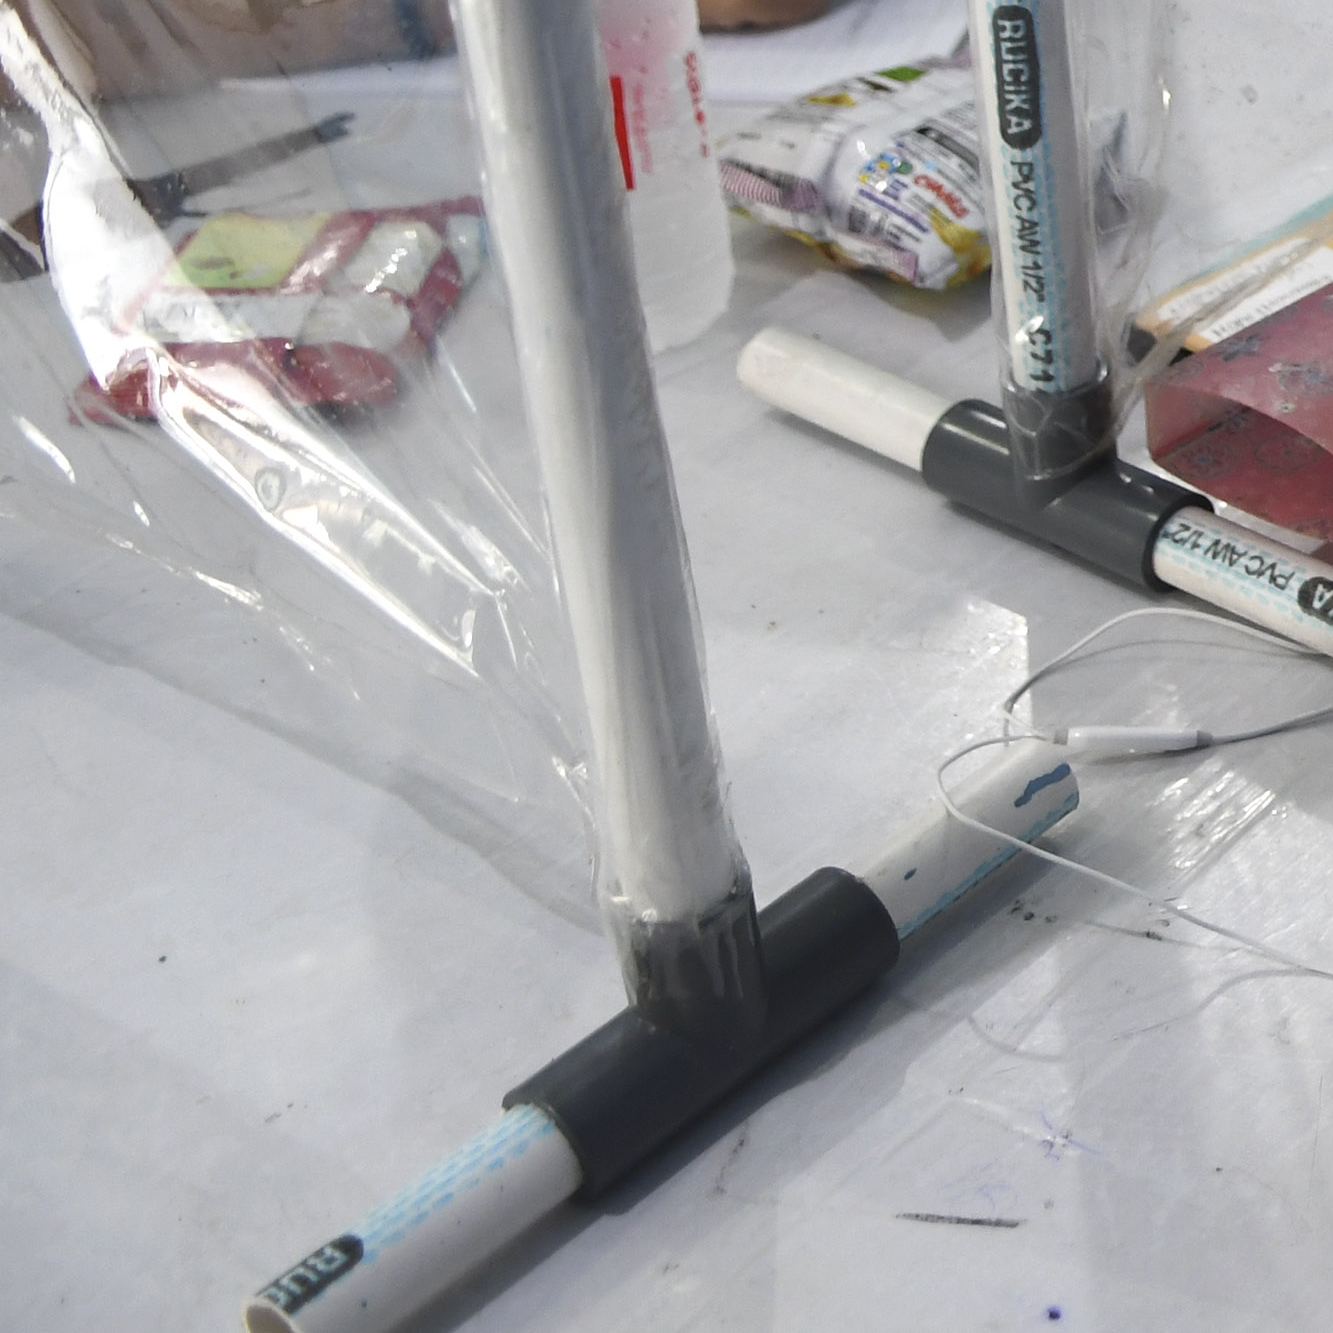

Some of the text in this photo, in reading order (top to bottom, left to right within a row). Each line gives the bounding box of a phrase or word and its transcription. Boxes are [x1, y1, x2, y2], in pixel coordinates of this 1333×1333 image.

[996, 18, 1033, 134] RUCIKA
[1010, 160, 1037, 212] PVC
[1016, 215, 1042, 256] AW
[1029, 328, 1056, 393] C71
[1204, 538, 1248, 568] AW
[1243, 554, 1296, 592] PVC
